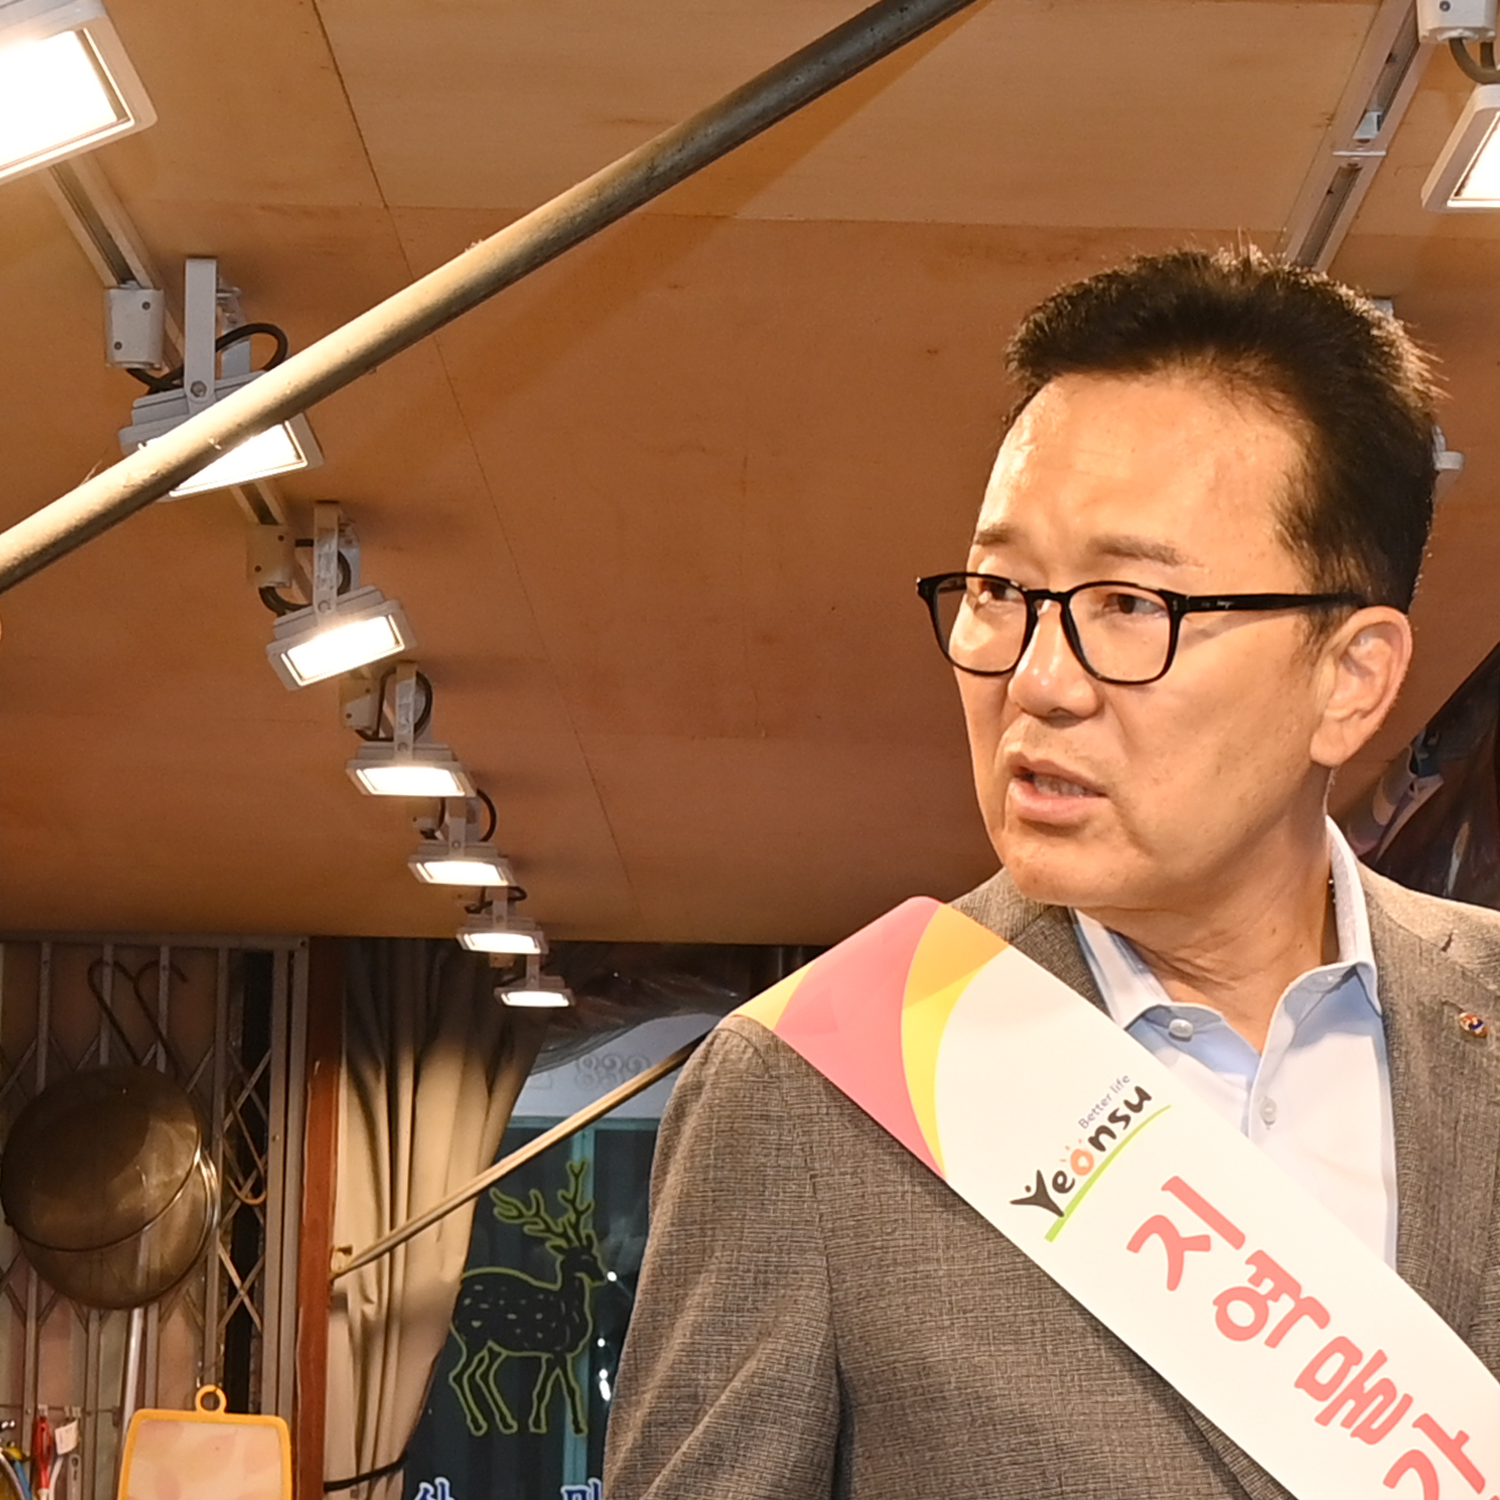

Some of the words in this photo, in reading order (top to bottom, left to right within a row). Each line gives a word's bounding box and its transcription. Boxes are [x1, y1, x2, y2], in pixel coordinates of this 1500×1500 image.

[1075, 1091, 1117, 1130] Better
[1108, 1071, 1133, 1095] life
[1010, 1084, 1153, 1217] Yeonsu
